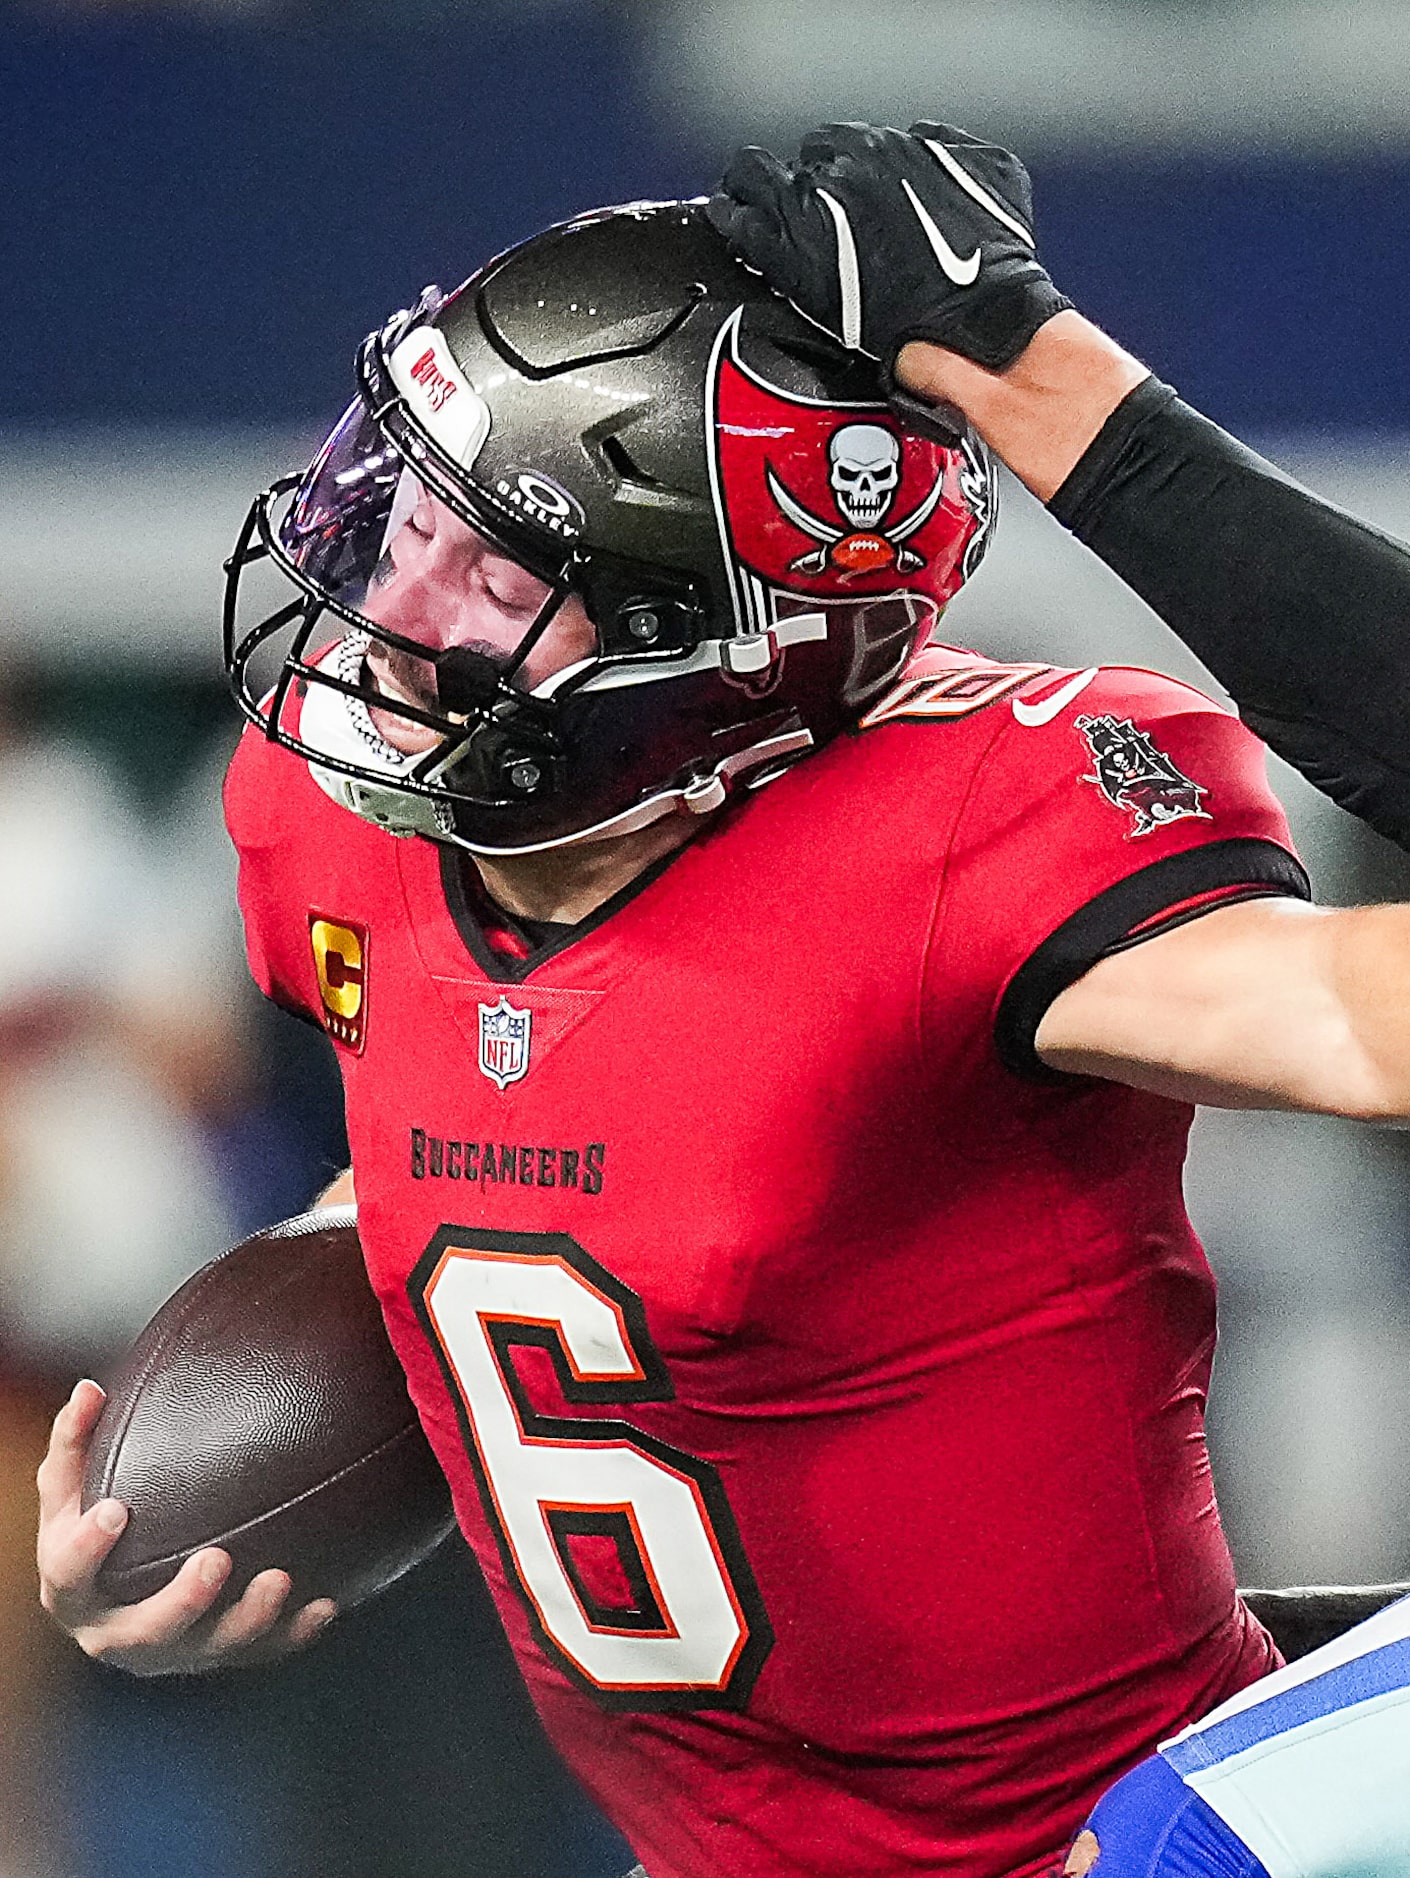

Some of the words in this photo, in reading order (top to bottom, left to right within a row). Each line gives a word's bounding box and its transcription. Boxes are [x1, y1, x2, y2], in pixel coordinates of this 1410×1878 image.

[497, 480, 577, 536] OAKLEY
[311, 919, 363, 1019] C
[486, 1038, 520, 1072] NFL
[411, 1127, 606, 1194] BUCCANEERS
[405, 1223, 775, 1712] 6
